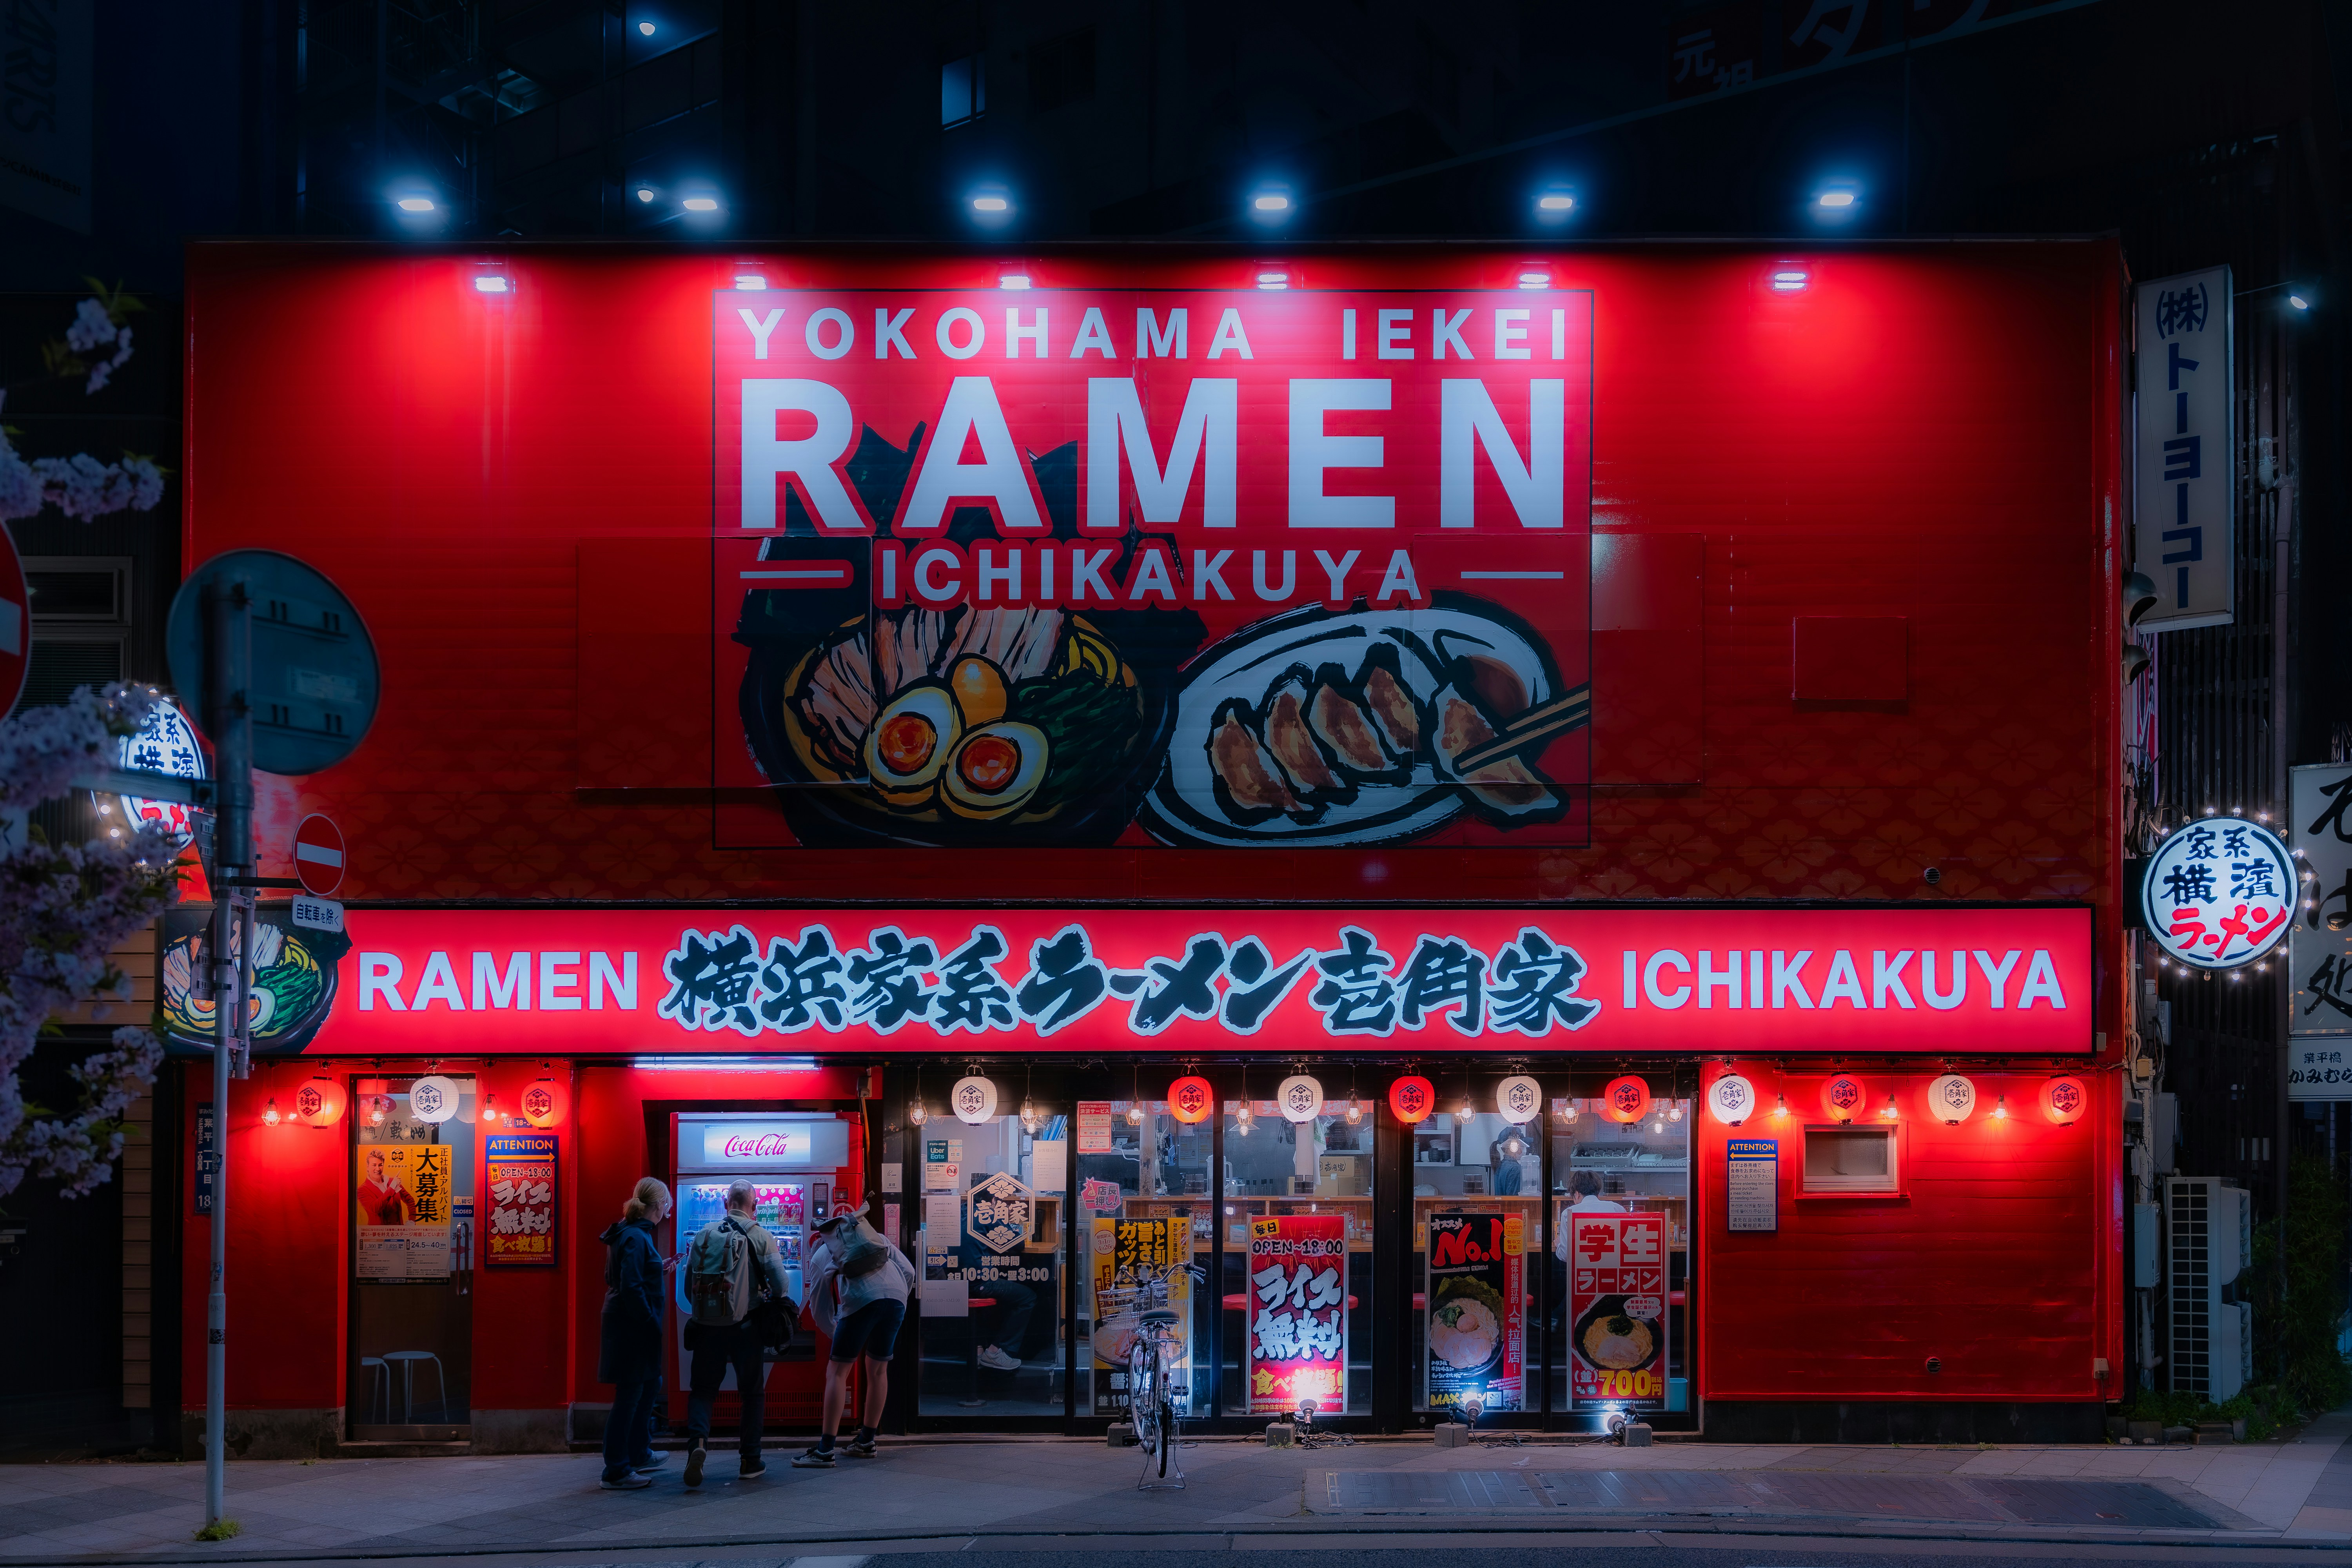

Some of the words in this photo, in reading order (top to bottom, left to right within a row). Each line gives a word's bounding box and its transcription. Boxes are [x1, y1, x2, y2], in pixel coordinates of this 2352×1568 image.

[739, 307, 1254, 359] YOKOHAMA
[1343, 308, 1564, 359] IEKEI
[740, 376, 1564, 528] RAMEN
[2156, 282, 2208, 609] (株)トーヨーコー
[884, 549, 1425, 601] ICHIKAKUYA
[2186, 826, 2251, 861] 家系
[2160, 858, 2279, 906] 横濱
[297, 903, 339, 926] 自転車を除く
[2169, 903, 2287, 959] ラーメン
[359, 951, 639, 1011] RAMEN
[1623, 949, 2067, 1010] ICHIKAKUYA
[2303, 1051, 2341, 1064] 業平橋
[2288, 1067, 2352, 1084] かみむら
[203, 1118, 213, 1184] 業平一丁目
[489, 1140, 553, 1150] ATTENTION
[724, 1133, 791, 1158] Coca-Cola
[415, 1148, 439, 1223] 大募集
[439, 1148, 448, 1223] 正社員・アルバイト
[490, 1179, 552, 1207] ライス
[1098, 1185, 1118, 1195] 店長
[198, 1195, 211, 1207] 18
[974, 1200, 1029, 1225] 壱角家
[1085, 1196, 1118, 1206] 一押し!
[490, 1207, 551, 1234] 無料
[887, 1218, 897, 1246] 警察官
[1255, 1221, 1277, 1235] 毎日
[1431, 1218, 1463, 1230] オススメ
[490, 1235, 552, 1253] 食べ放題!
[1432, 1218, 1504, 1267] No.1
[1579, 1223, 1660, 1263] 学生
[981, 1256, 1020, 1267] 営業時間
[1252, 1263, 1341, 1310] ライス
[1577, 1270, 1660, 1290] ラーメン
[1252, 1308, 1341, 1360] 無料
[1599, 1369, 1651, 1396] 700
